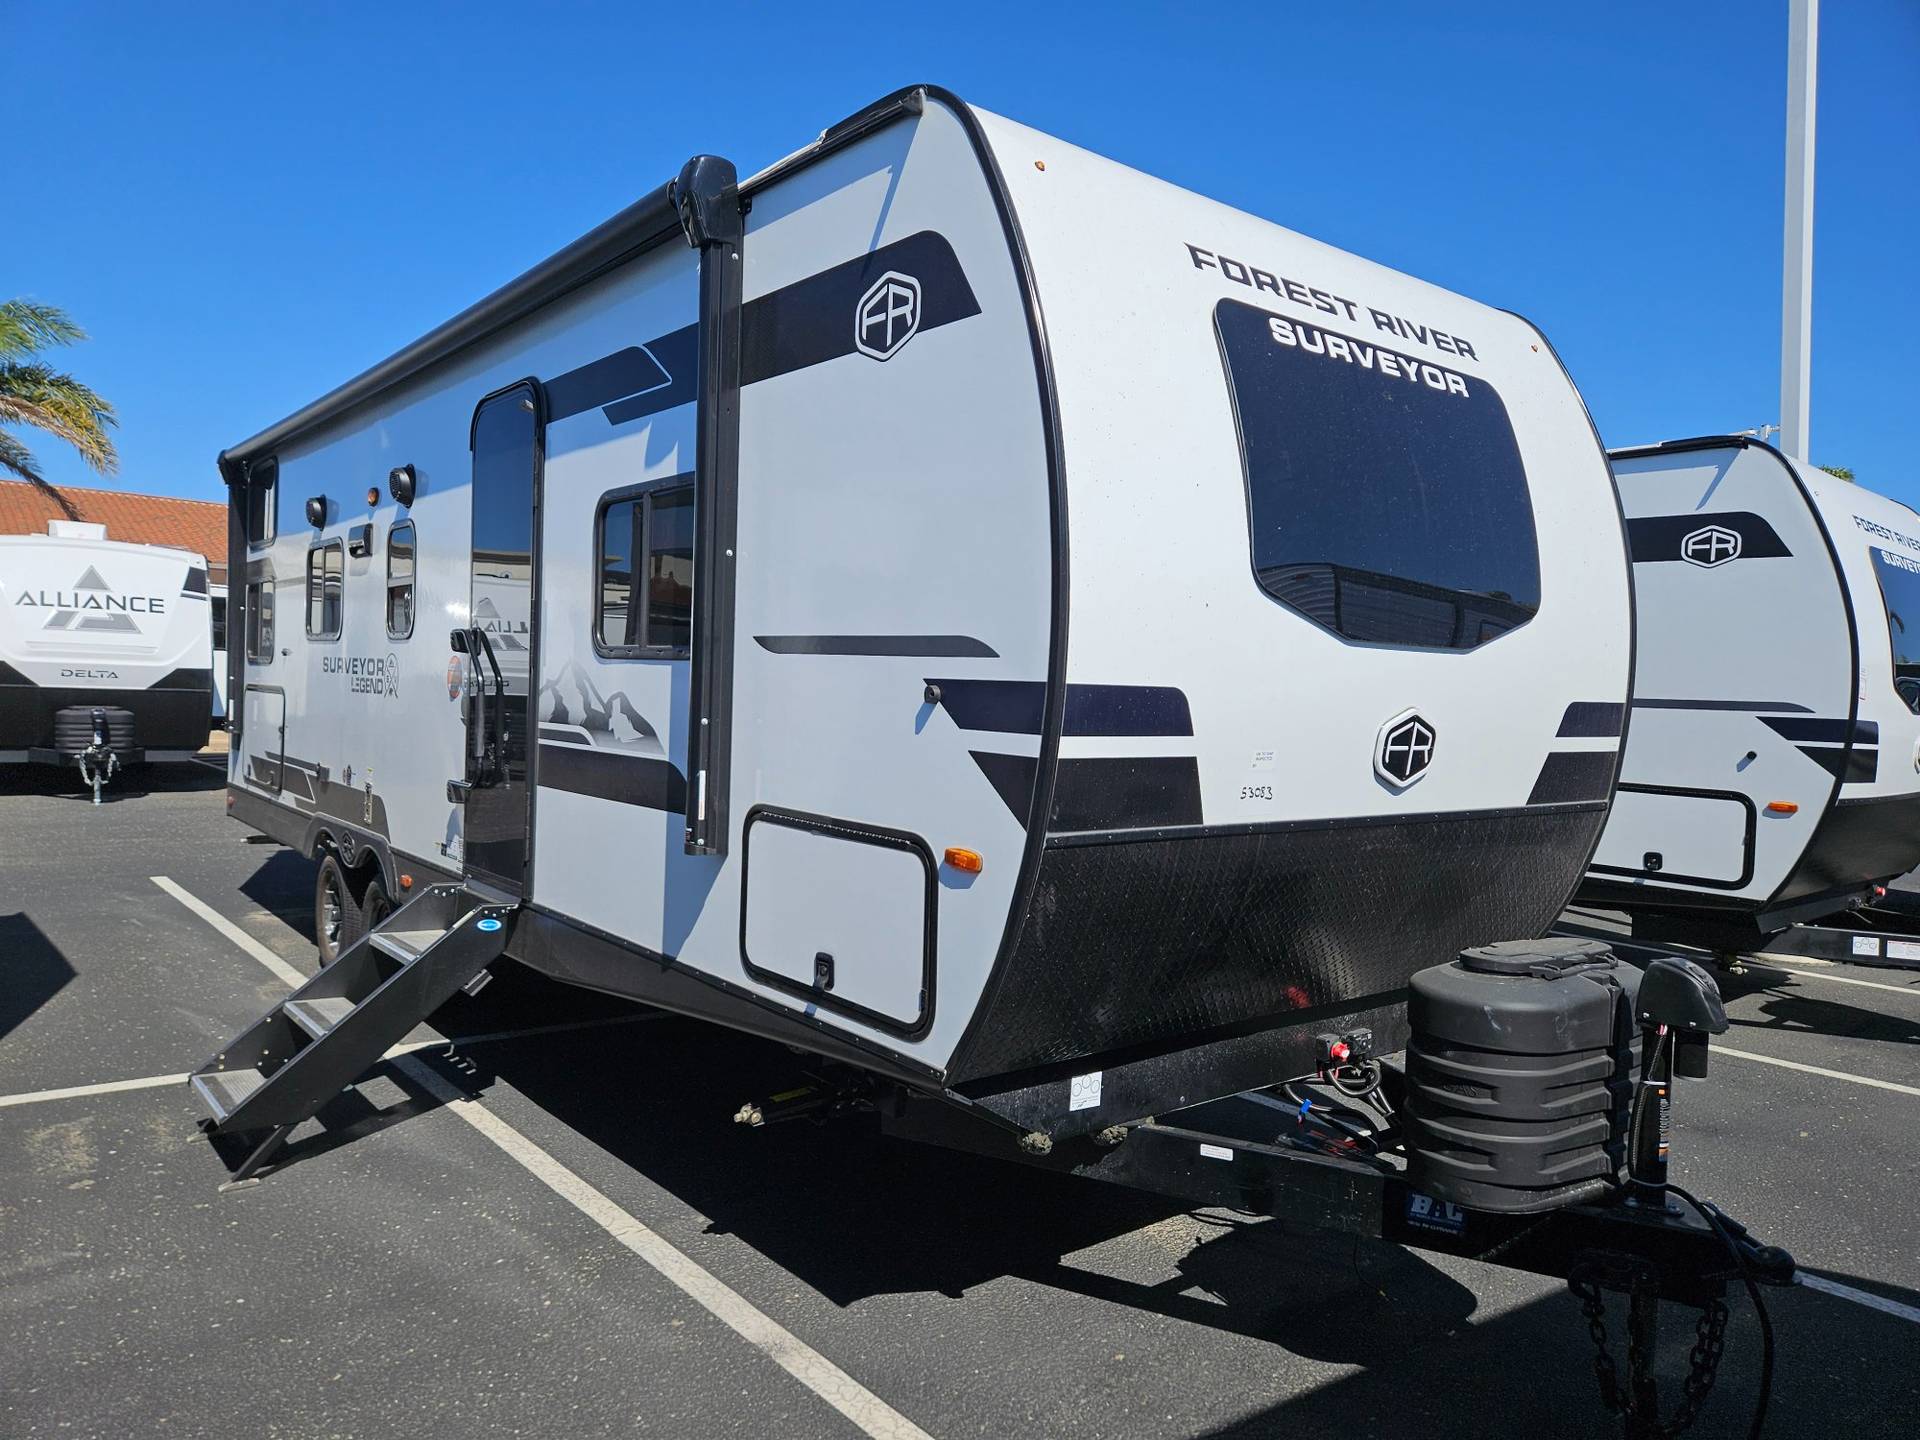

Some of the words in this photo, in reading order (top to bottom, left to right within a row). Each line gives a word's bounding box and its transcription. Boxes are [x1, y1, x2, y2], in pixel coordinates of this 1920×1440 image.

[1184, 241, 1358, 322] FOREST
[1367, 306, 1480, 362] RIVER
[1268, 317, 1469, 398] SURVEYOR
[1851, 514, 1894, 541] FOREST
[15, 590, 165, 613] ALLIANCE
[60, 669, 119, 679] DELTA
[323, 656, 385, 677] SURVEYOR
[351, 677, 384, 694] LEGEND
